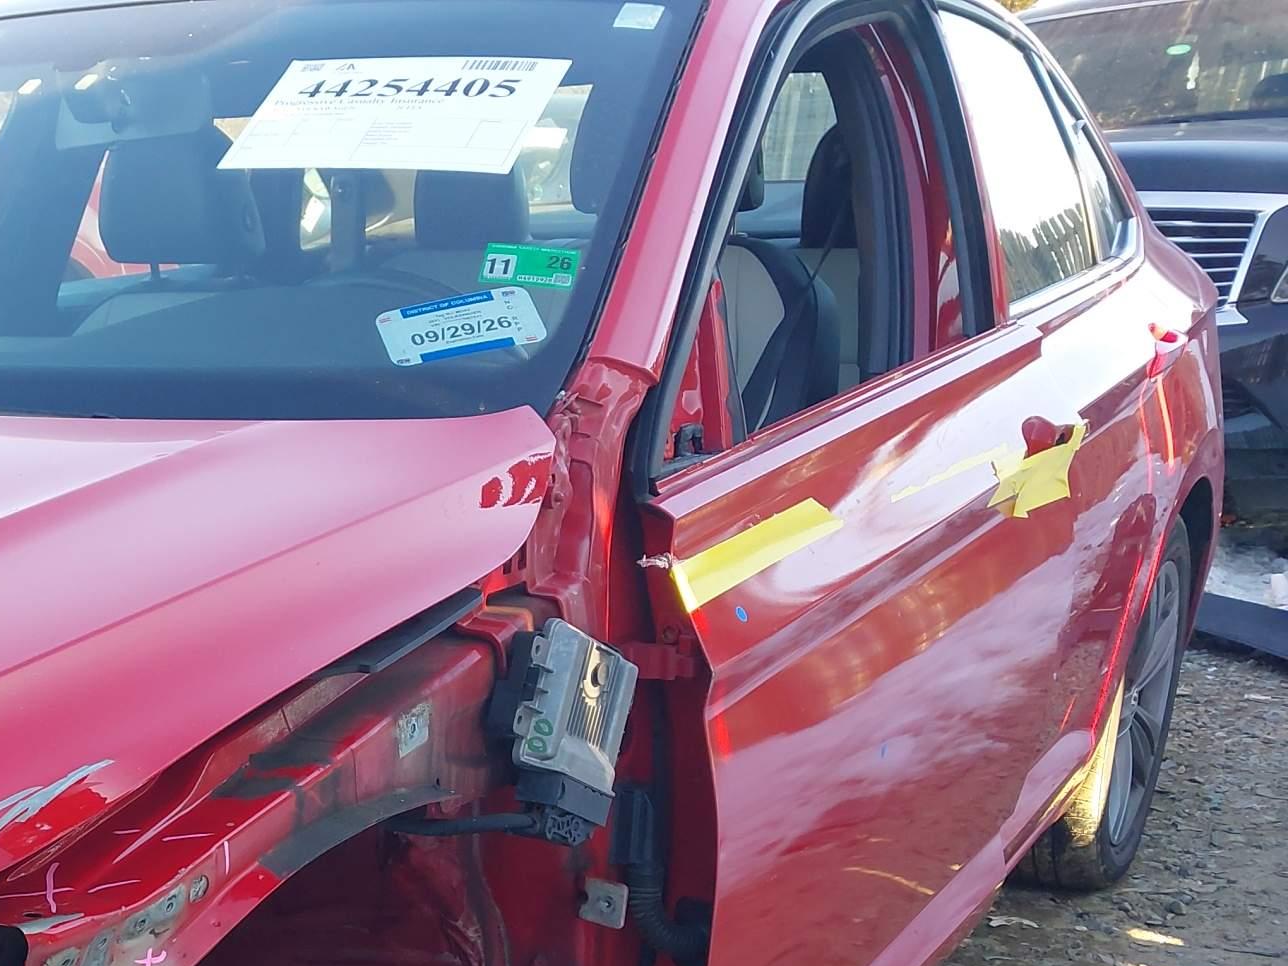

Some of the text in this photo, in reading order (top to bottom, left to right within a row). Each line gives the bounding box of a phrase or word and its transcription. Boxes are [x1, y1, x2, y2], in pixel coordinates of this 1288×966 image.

[298, 78, 524, 98] 44254405
[488, 258, 510, 275] 11
[547, 255, 572, 270] 26
[411, 316, 512, 346] 09/29/26
